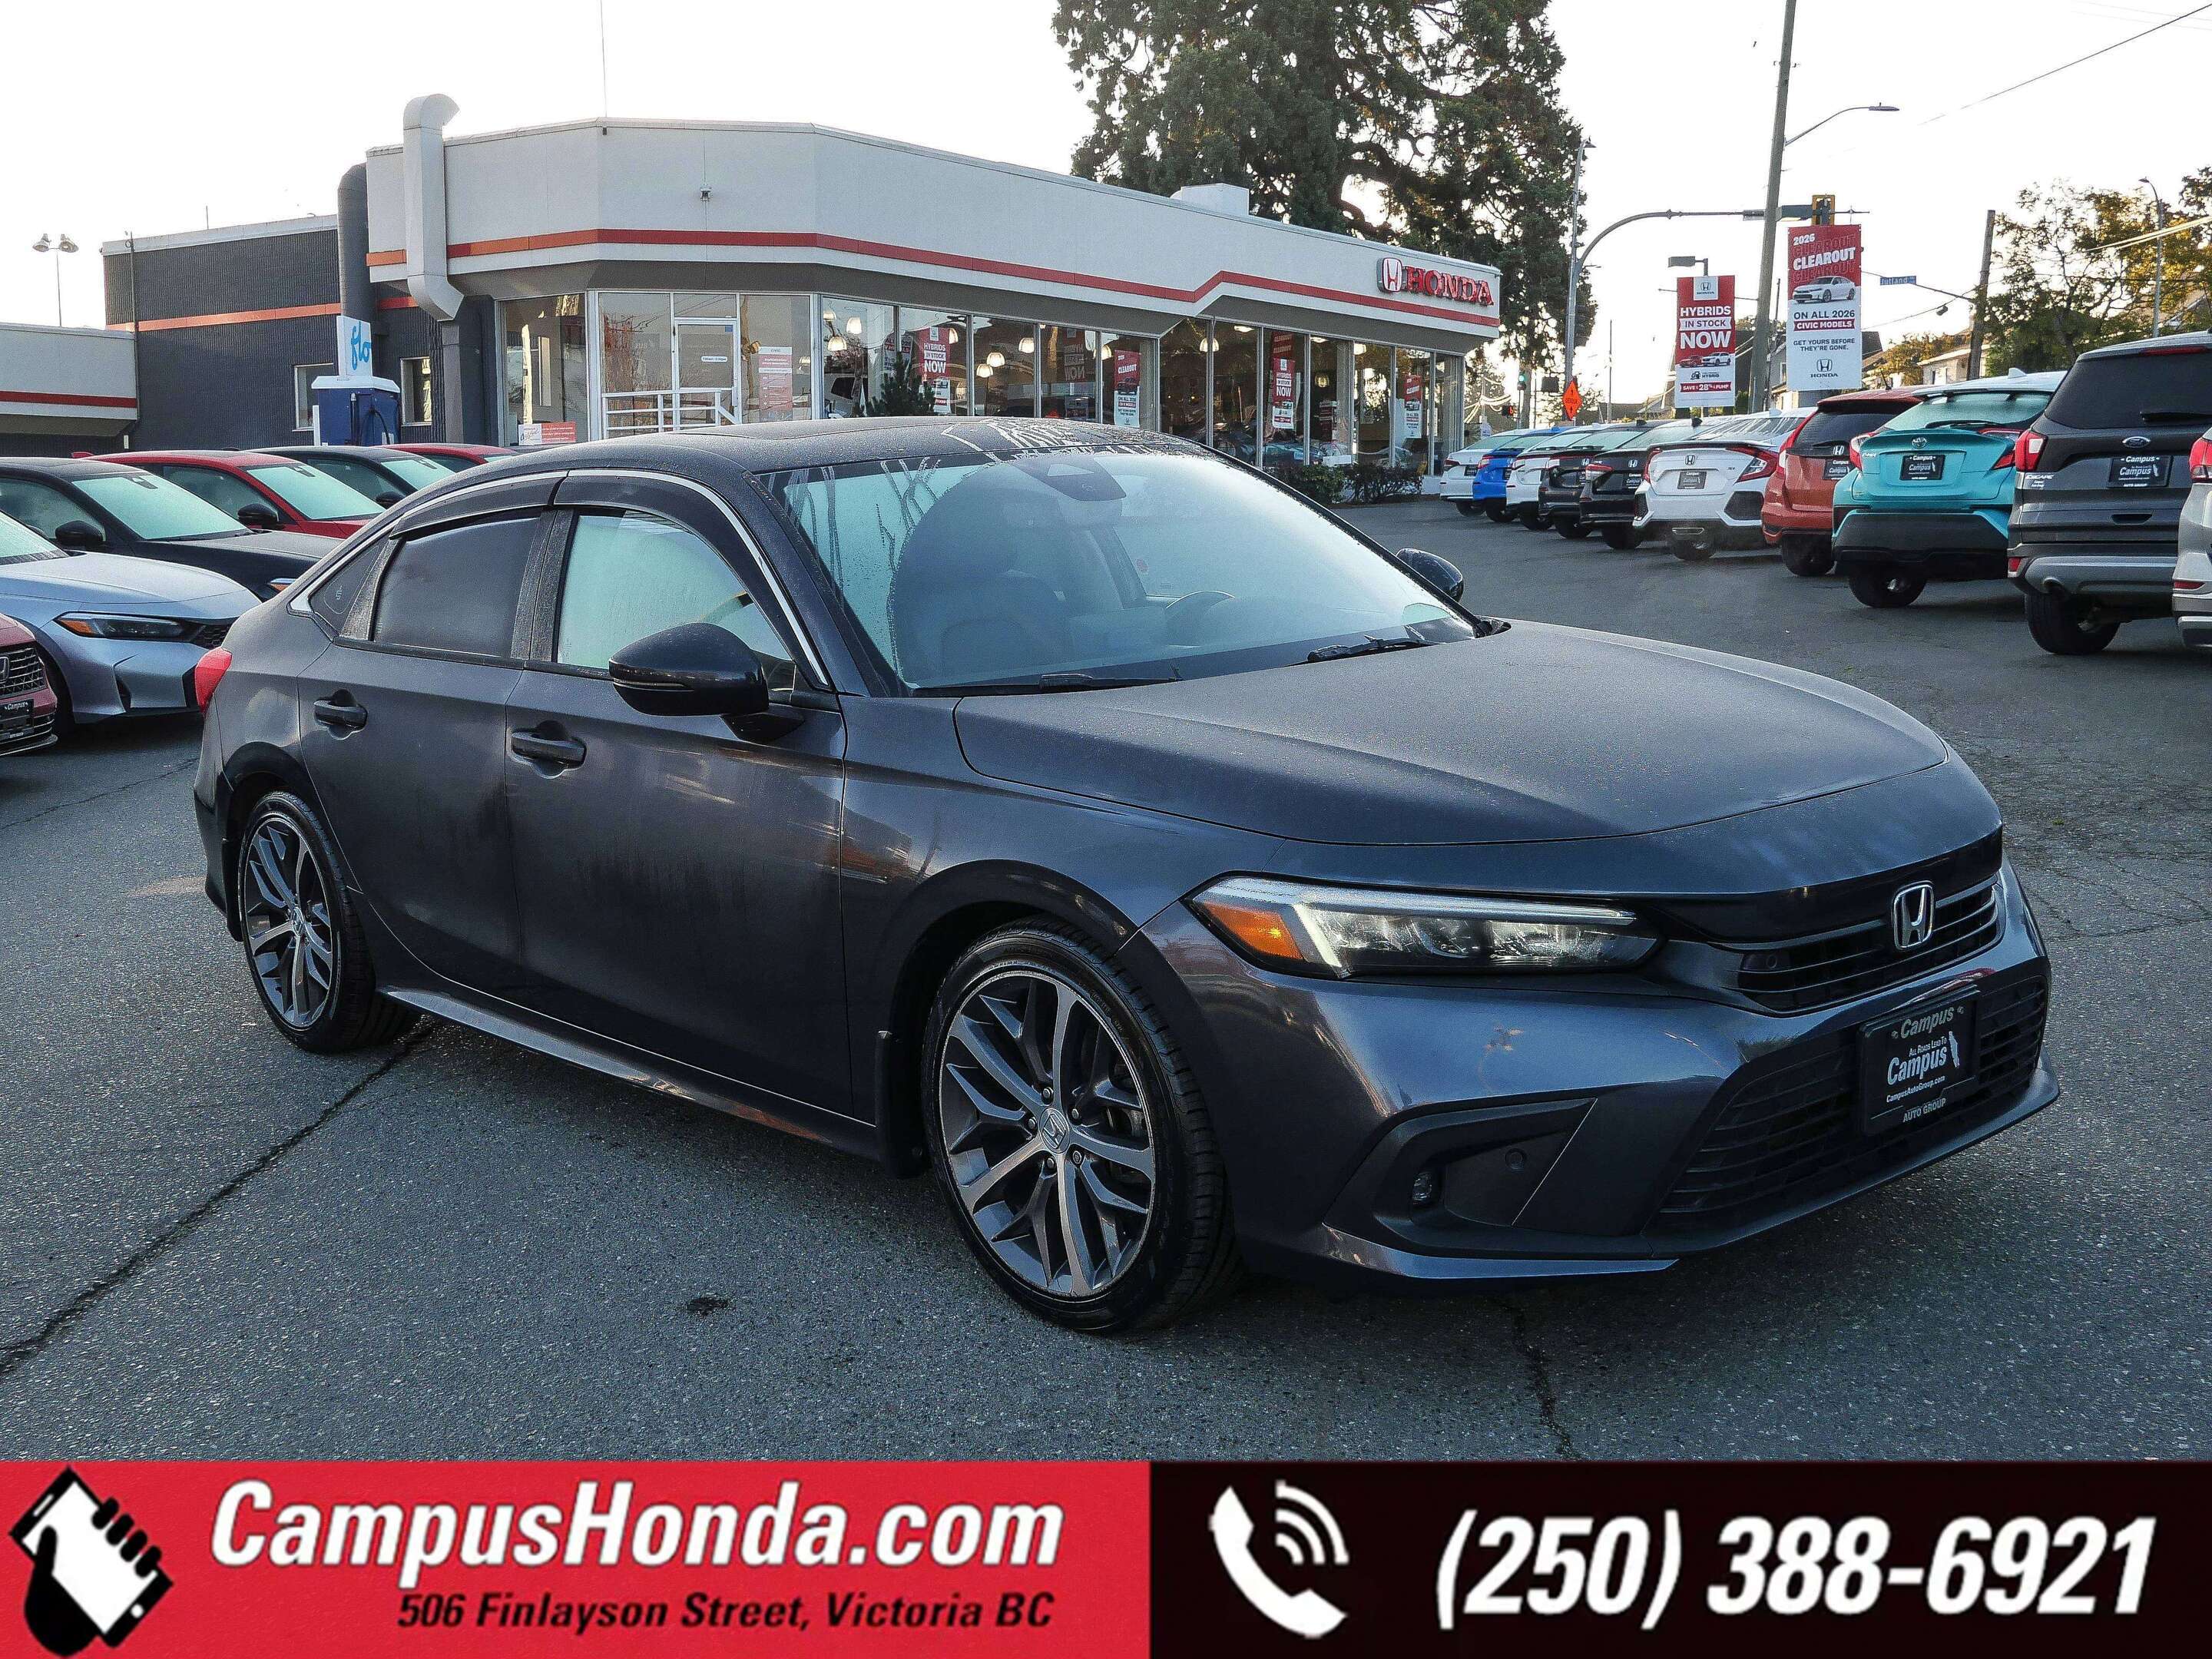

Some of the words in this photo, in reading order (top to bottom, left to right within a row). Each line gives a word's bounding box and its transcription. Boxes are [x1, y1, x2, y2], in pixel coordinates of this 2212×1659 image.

[1793, 247, 1856, 270] CLEAROUT
[1404, 266, 1495, 306] HONDA
[1680, 306, 1731, 316] HYBRIDS
[1832, 310, 1855, 318] 2026
[350, 320, 373, 370] flo
[923, 343, 946, 352] HYBRIDS
[1680, 331, 1731, 349] NOW
[924, 360, 946, 373] NOW
[1277, 386, 1291, 397] NOW
[2120, 467, 2152, 476] Campus
[1901, 1007, 1954, 1038] Campus
[1887, 1046, 1947, 1085] Campus
[1886, 1075, 1945, 1103] CampusAutoGroup.com
[1902, 1107, 1922, 1123] AUTO
[1923, 1098, 1946, 1114] GROUP
